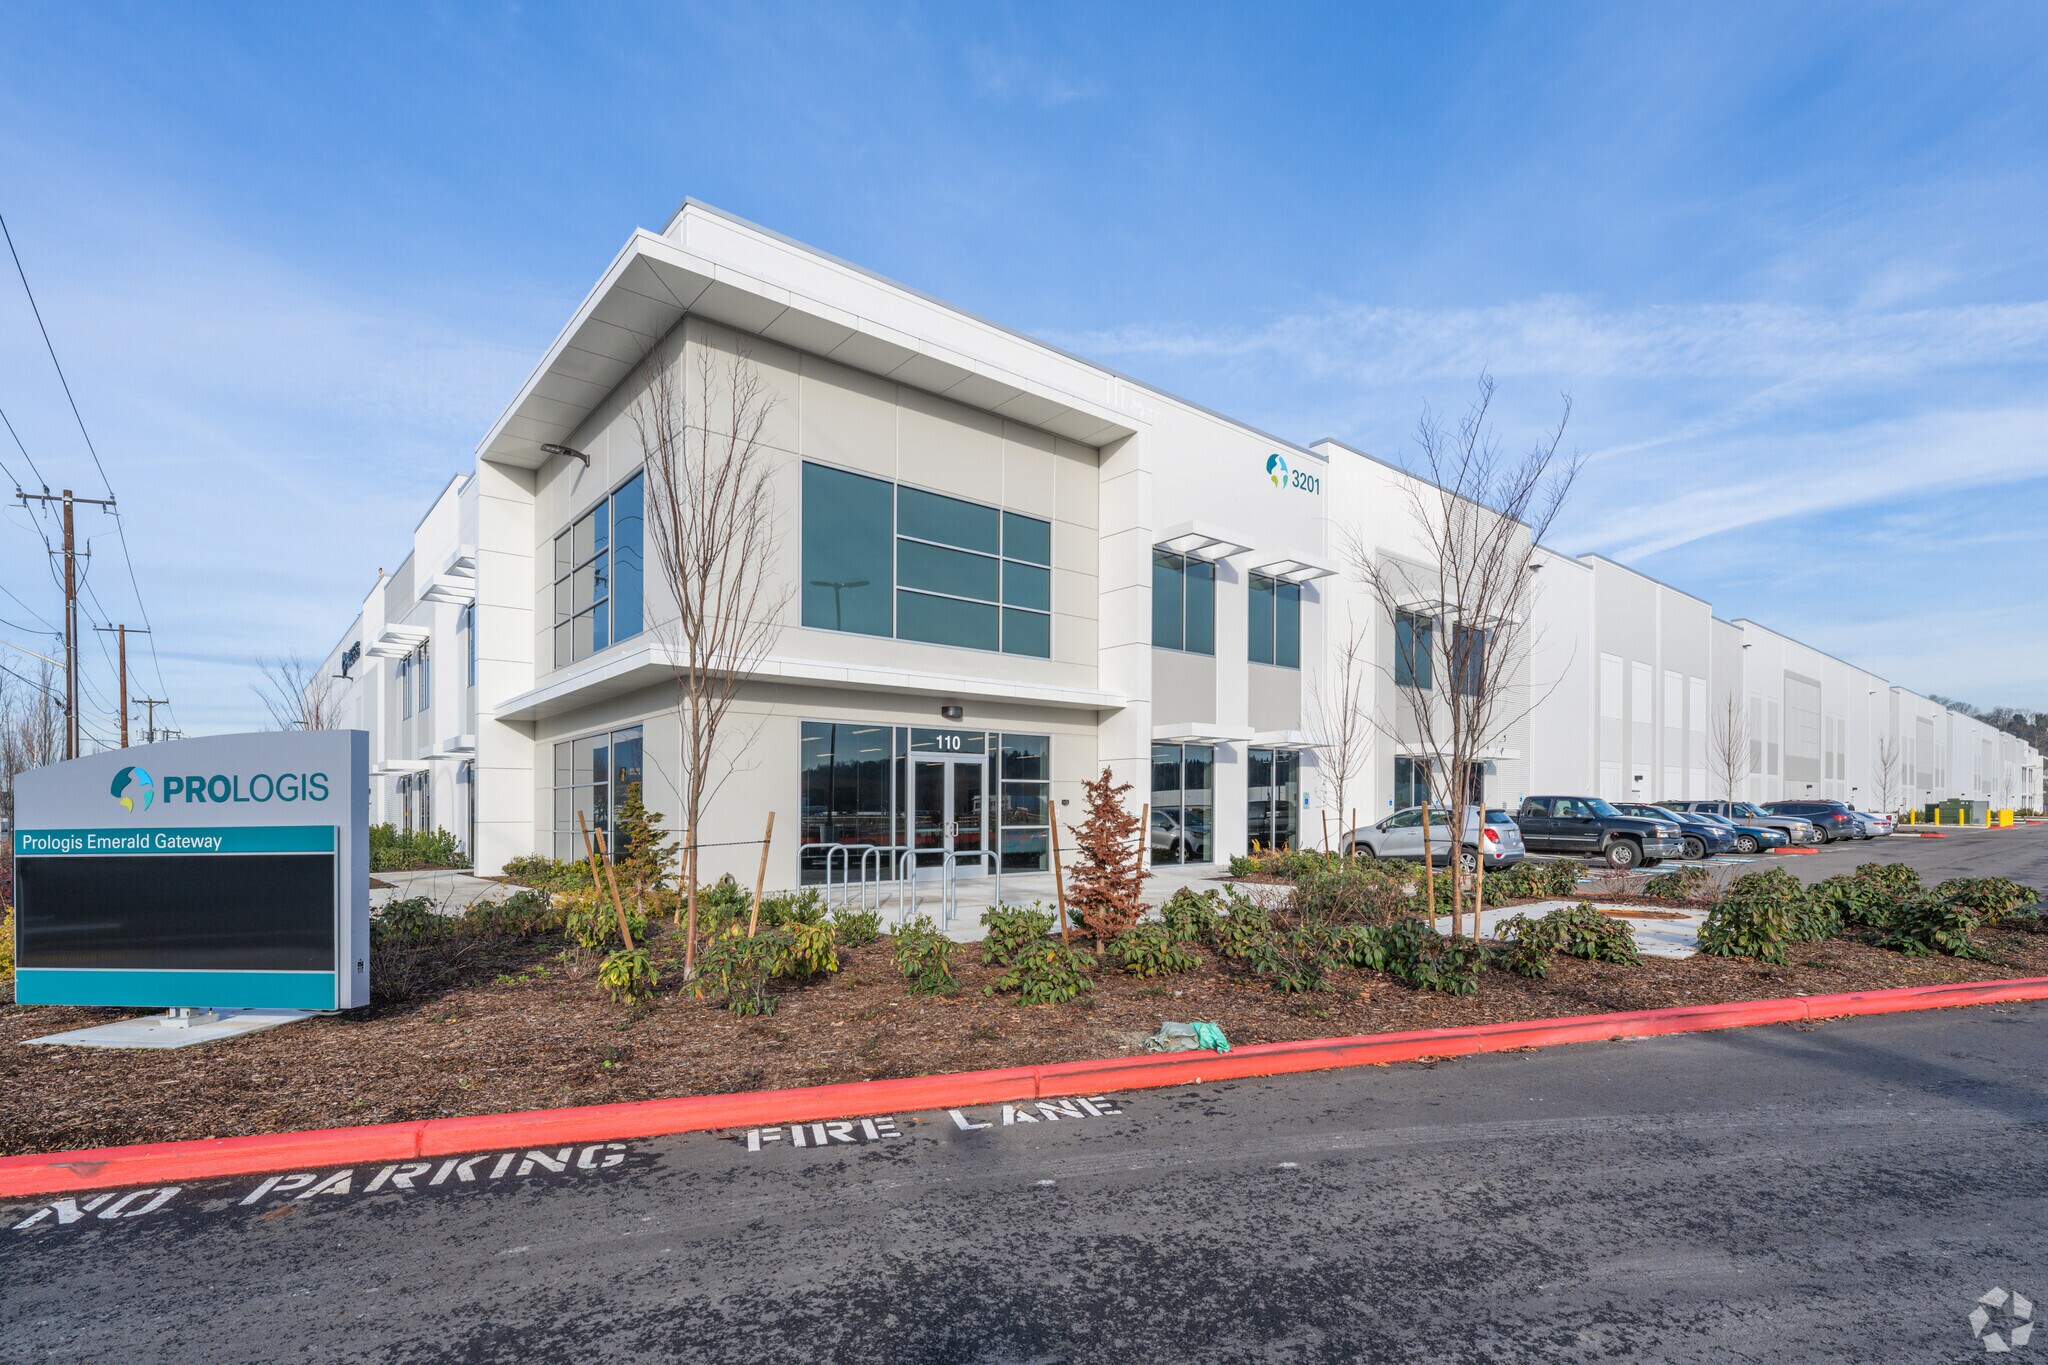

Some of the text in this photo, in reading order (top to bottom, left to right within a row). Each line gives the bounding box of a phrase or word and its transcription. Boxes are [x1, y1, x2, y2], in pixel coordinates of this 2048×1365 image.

[1292, 469, 1320, 495] 3201
[936, 734, 961, 750] 110
[163, 772, 330, 803] PROLOGIS
[22, 833, 223, 853] Prologis Emerald Gateway
[12, 1096, 1124, 1230] NO PARKING FIRE LANE
